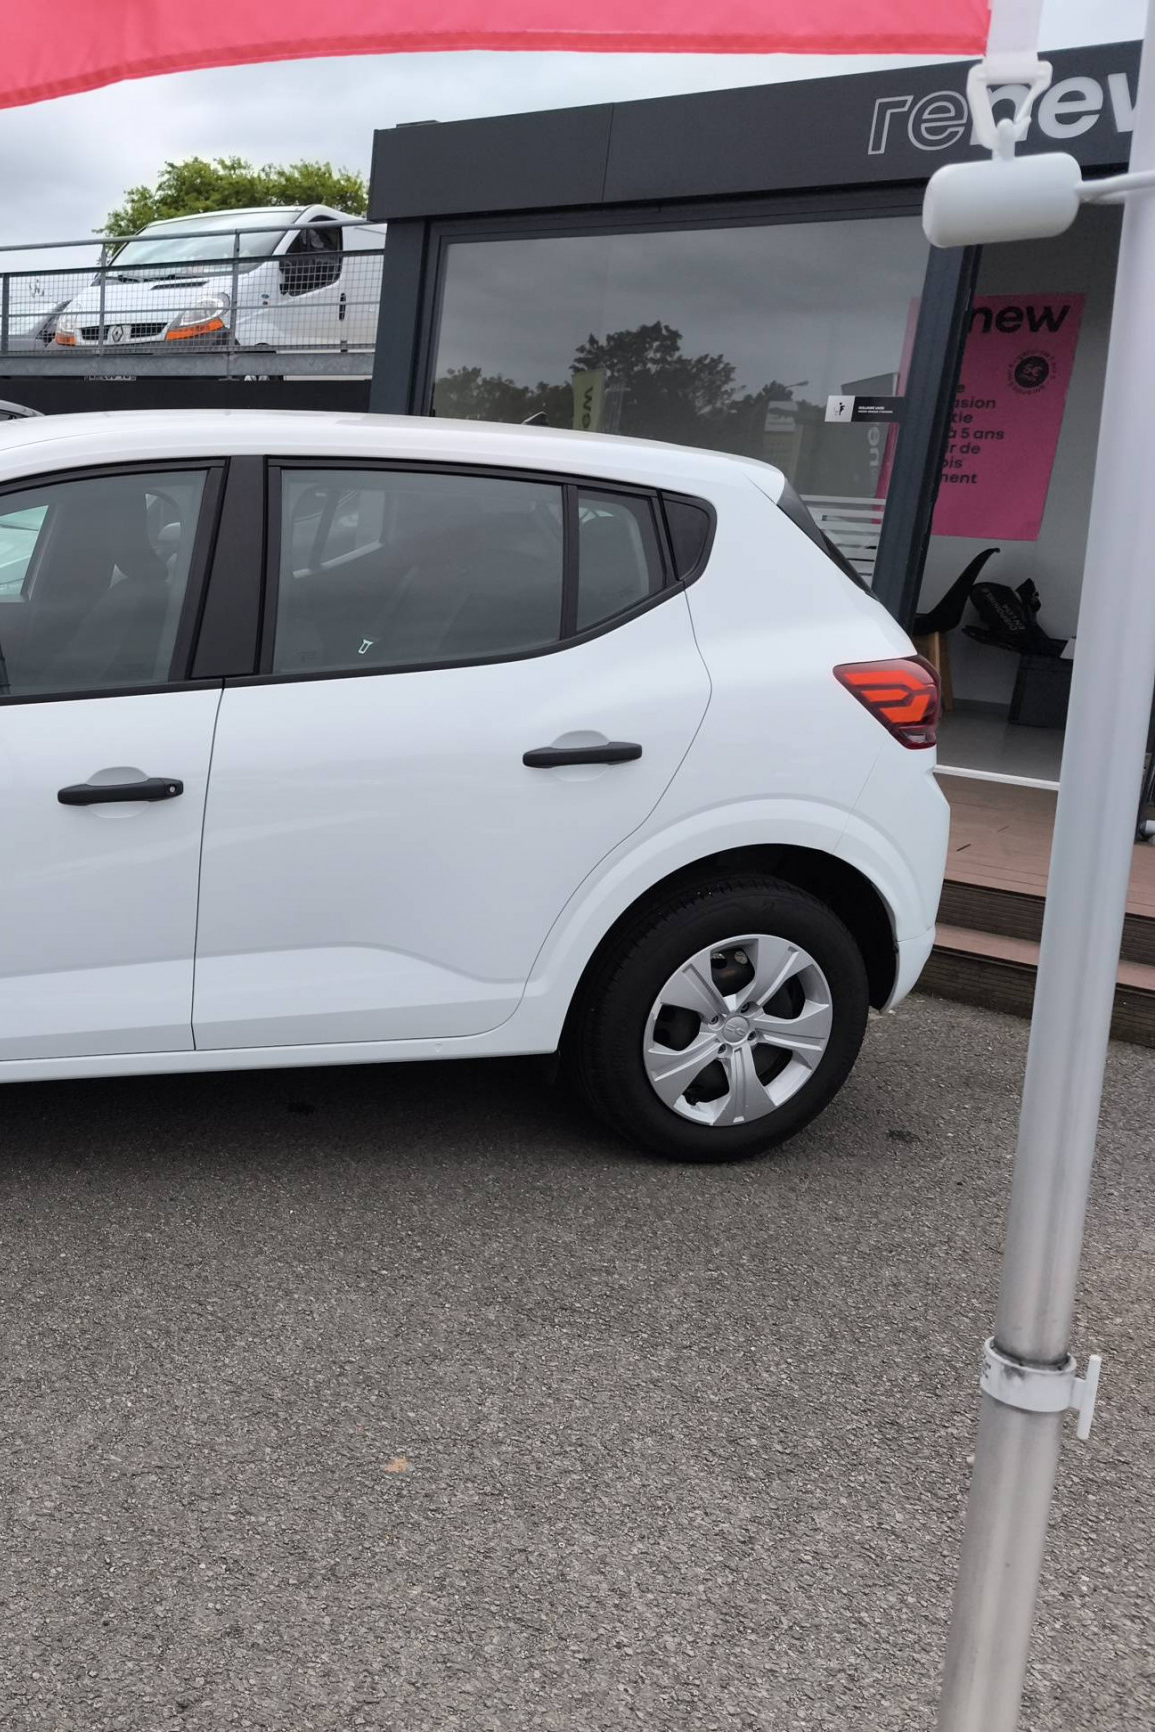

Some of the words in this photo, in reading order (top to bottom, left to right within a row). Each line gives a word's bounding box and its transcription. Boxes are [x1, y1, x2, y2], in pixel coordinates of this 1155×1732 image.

[967, 305, 1071, 334] new
[961, 427, 970, 439] 5
[973, 430, 1005, 440] ans
[959, 442, 981, 455] de
